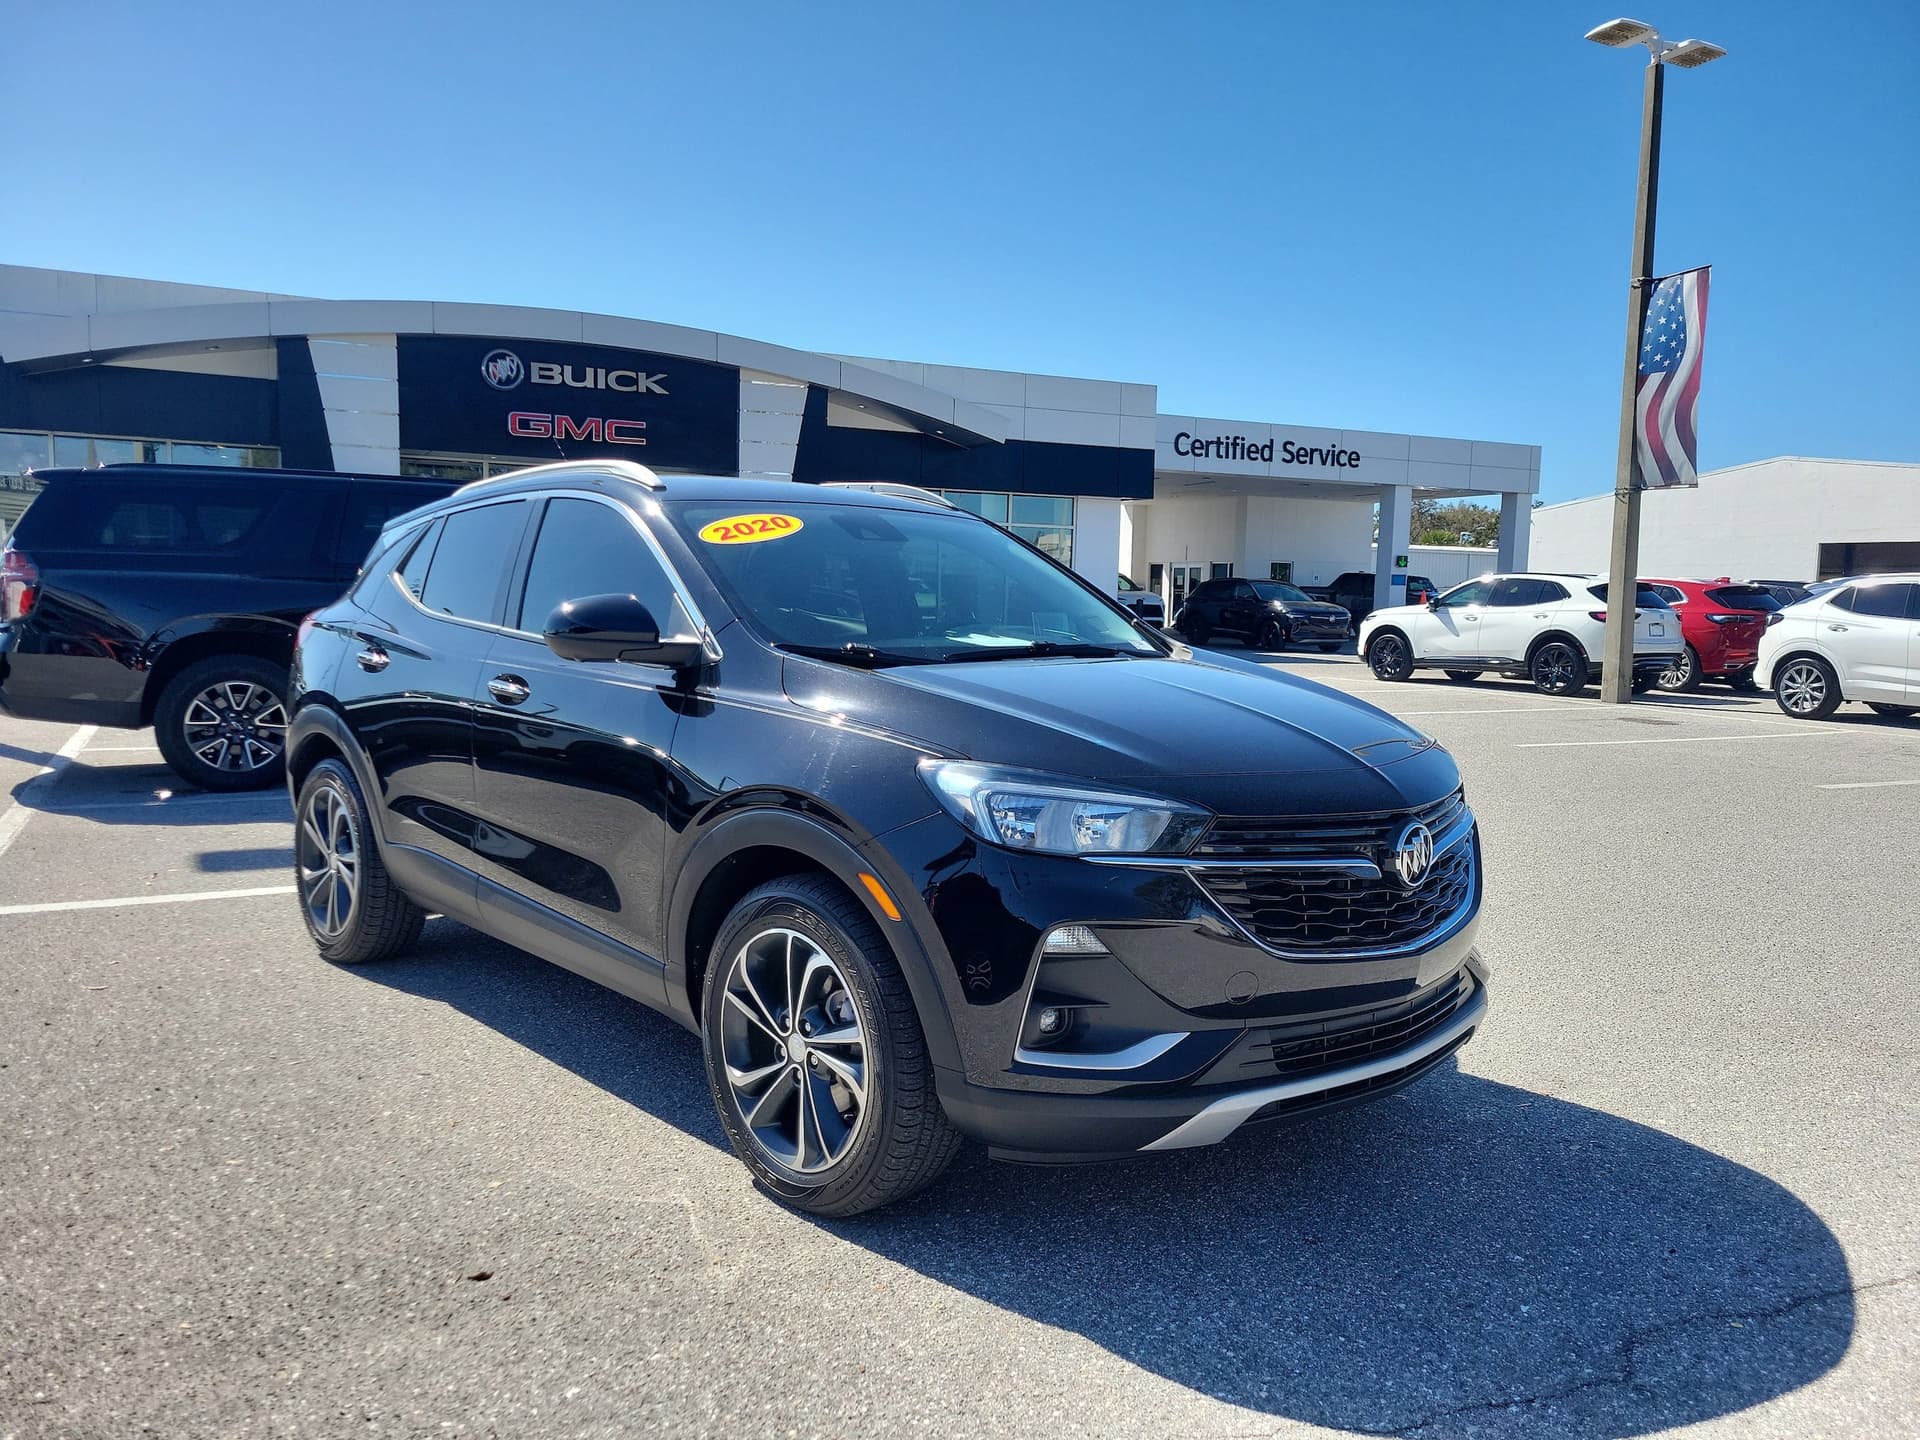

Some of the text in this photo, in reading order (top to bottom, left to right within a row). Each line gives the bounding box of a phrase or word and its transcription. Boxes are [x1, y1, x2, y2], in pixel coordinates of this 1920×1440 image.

[530, 362, 670, 395] BUICK
[508, 411, 647, 445] GMC
[1174, 432, 1361, 468] Certified Service
[713, 516, 791, 541] 2020
